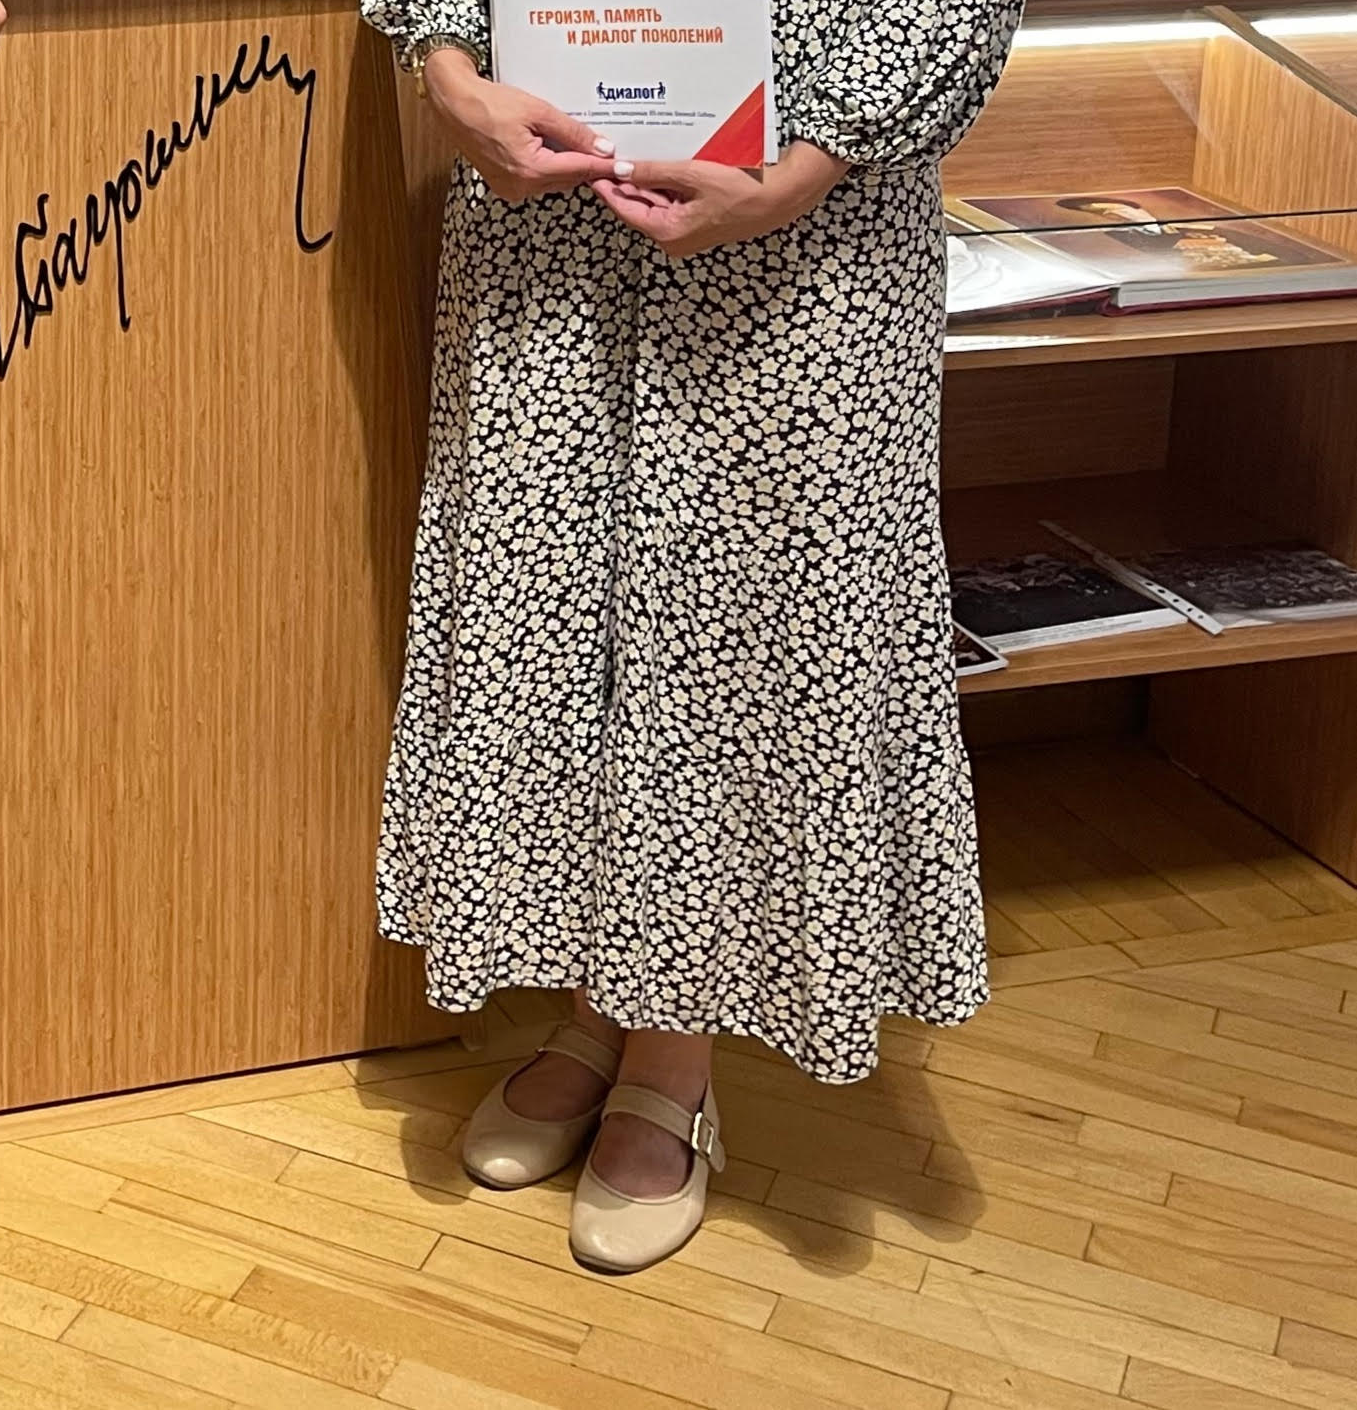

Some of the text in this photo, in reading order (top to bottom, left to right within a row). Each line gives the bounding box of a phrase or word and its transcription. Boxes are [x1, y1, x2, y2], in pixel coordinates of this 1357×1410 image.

[529, 7, 662, 25] ГЕРОИЗМ, ПАМЯТЬ
[567, 26, 723, 46] И ДИАЛОГ ПОКОЛЕНИЙ
